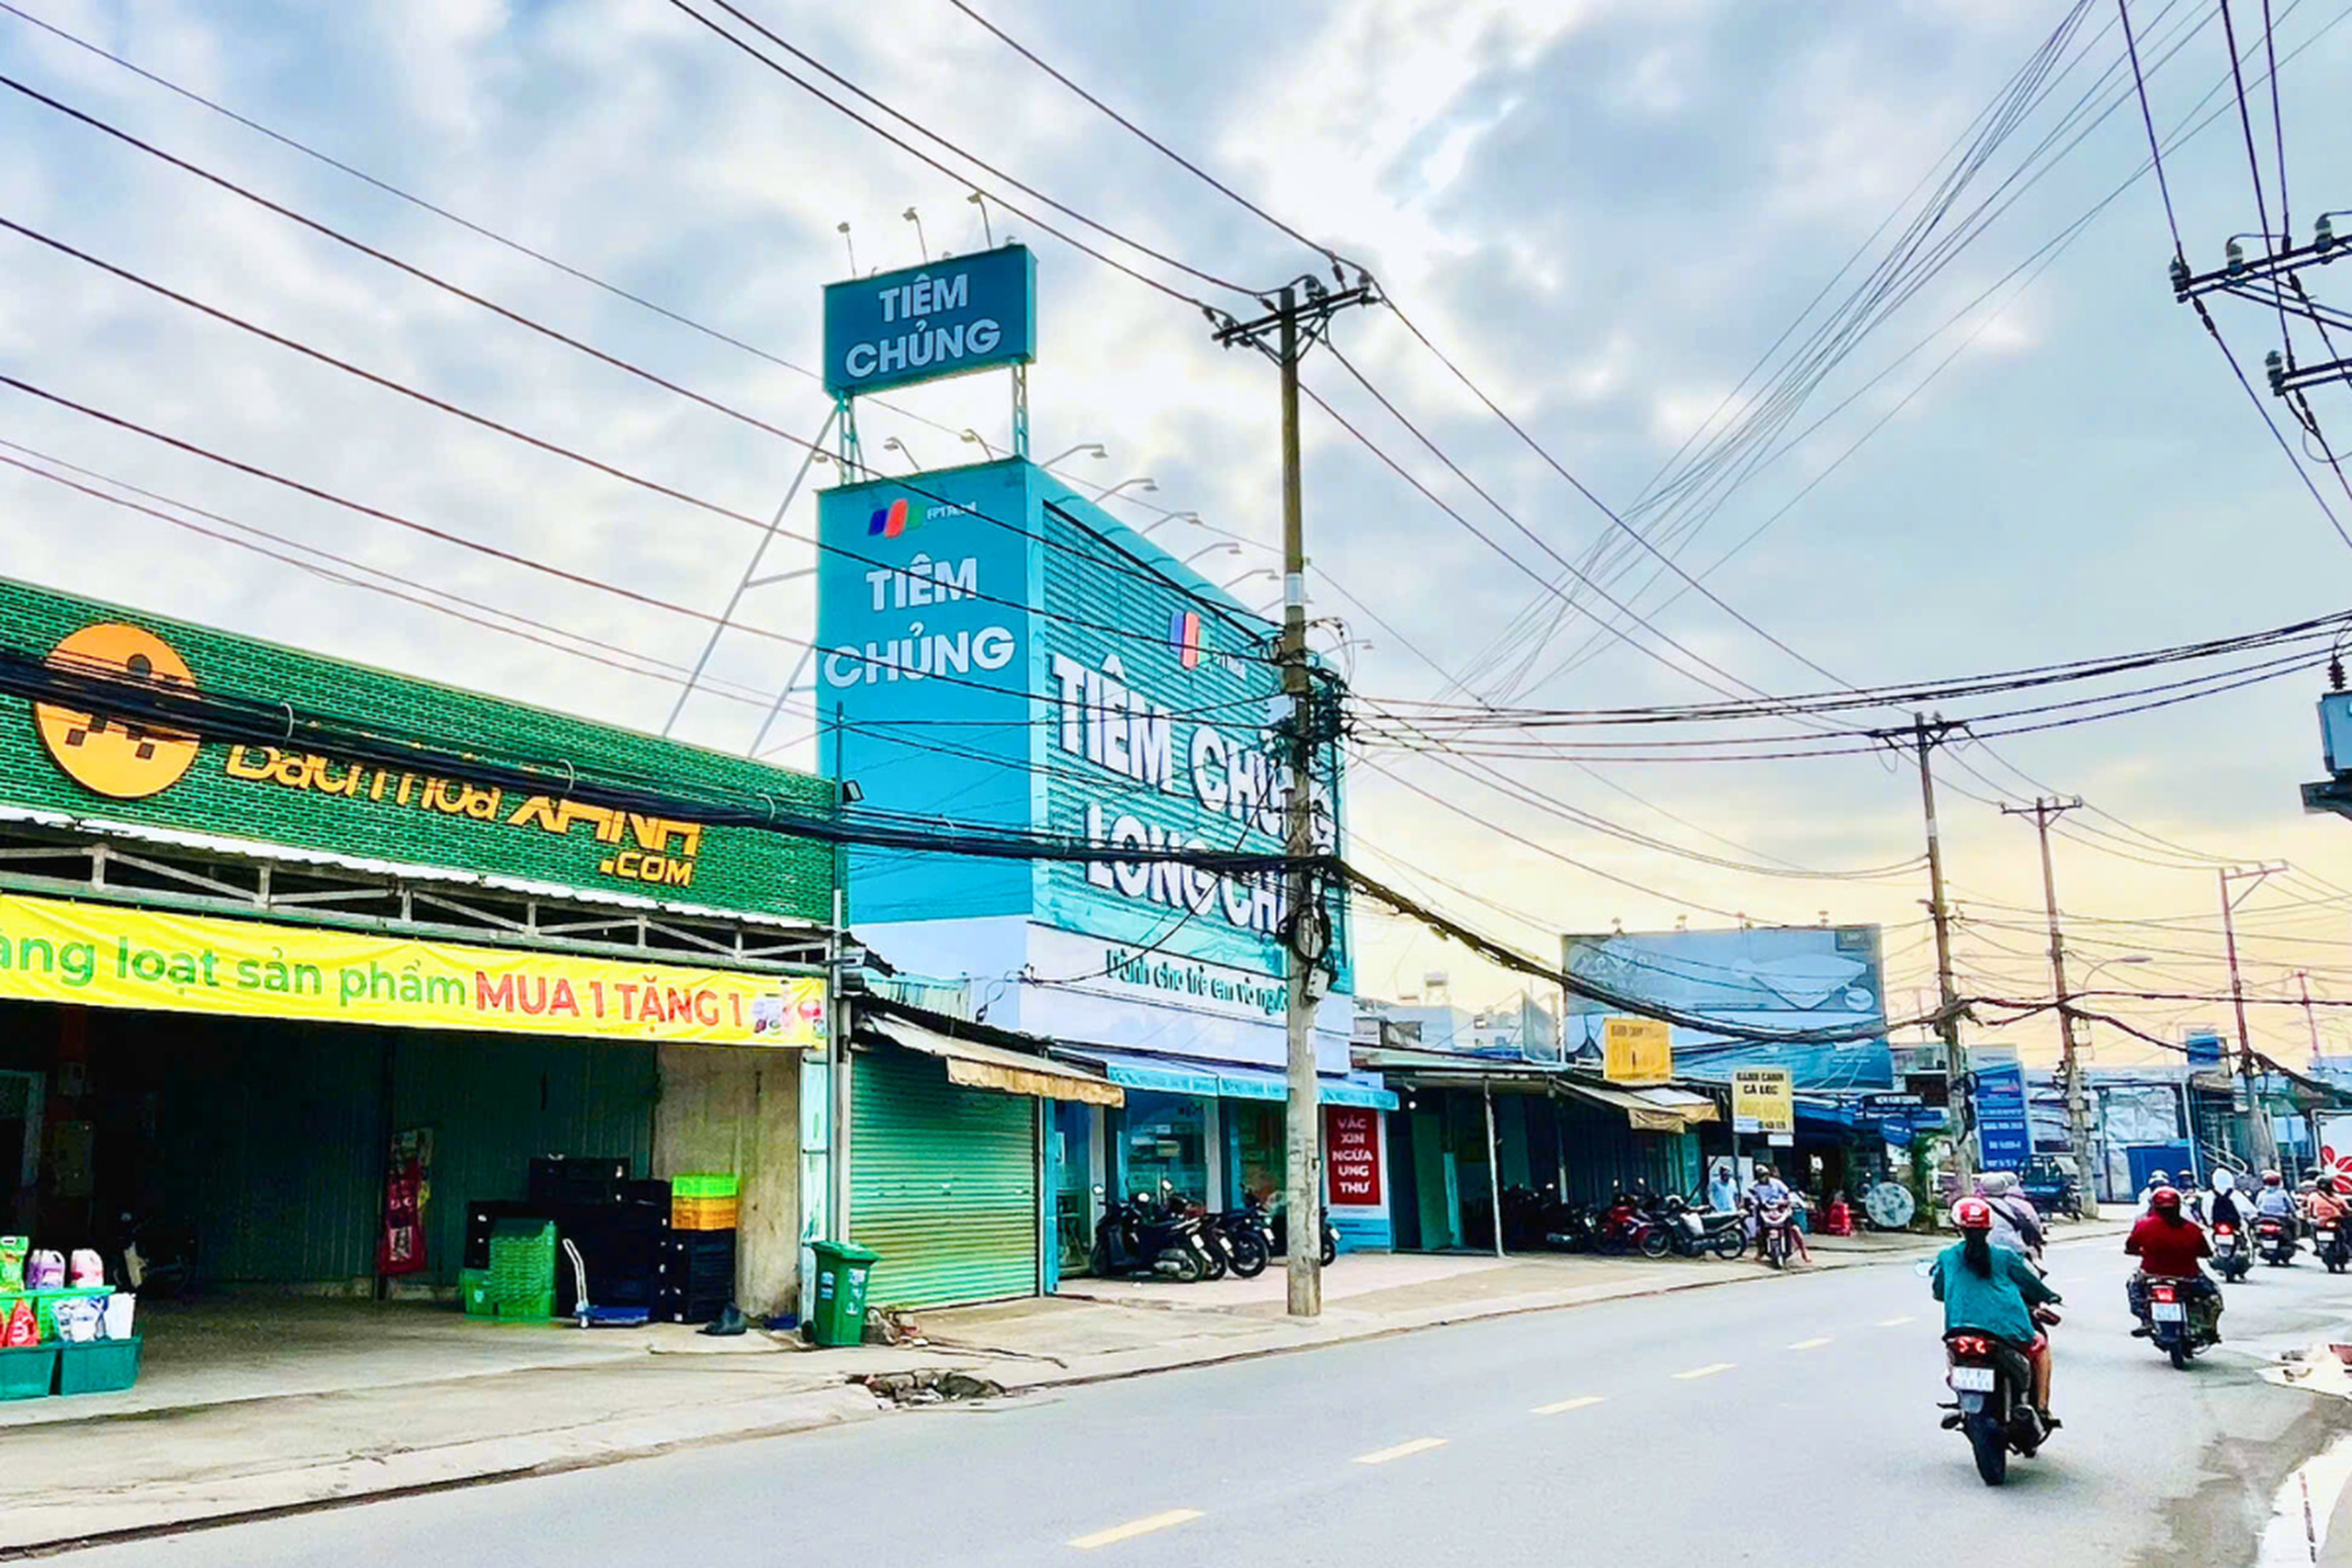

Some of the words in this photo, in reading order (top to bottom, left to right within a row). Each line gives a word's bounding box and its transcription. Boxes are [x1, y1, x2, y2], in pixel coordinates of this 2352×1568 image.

[878, 273, 968, 322] TIÊM
[845, 319, 1001, 378] CHỦNG
[865, 553, 978, 612] TIÊM
[823, 622, 1016, 688] CHỦNG
[1050, 650, 1174, 793] TIÊM
[1188, 725, 1339, 854] CHG
[117, 935, 220, 995] loạt
[236, 946, 322, 995] sản
[339, 959, 466, 1007] phẩm
[475, 971, 581, 1017] MUA
[589, 981, 605, 1019] 1
[614, 975, 720, 1032] TẶNG
[729, 993, 742, 1027] 1
[1338, 1165, 1370, 1177] UNG
